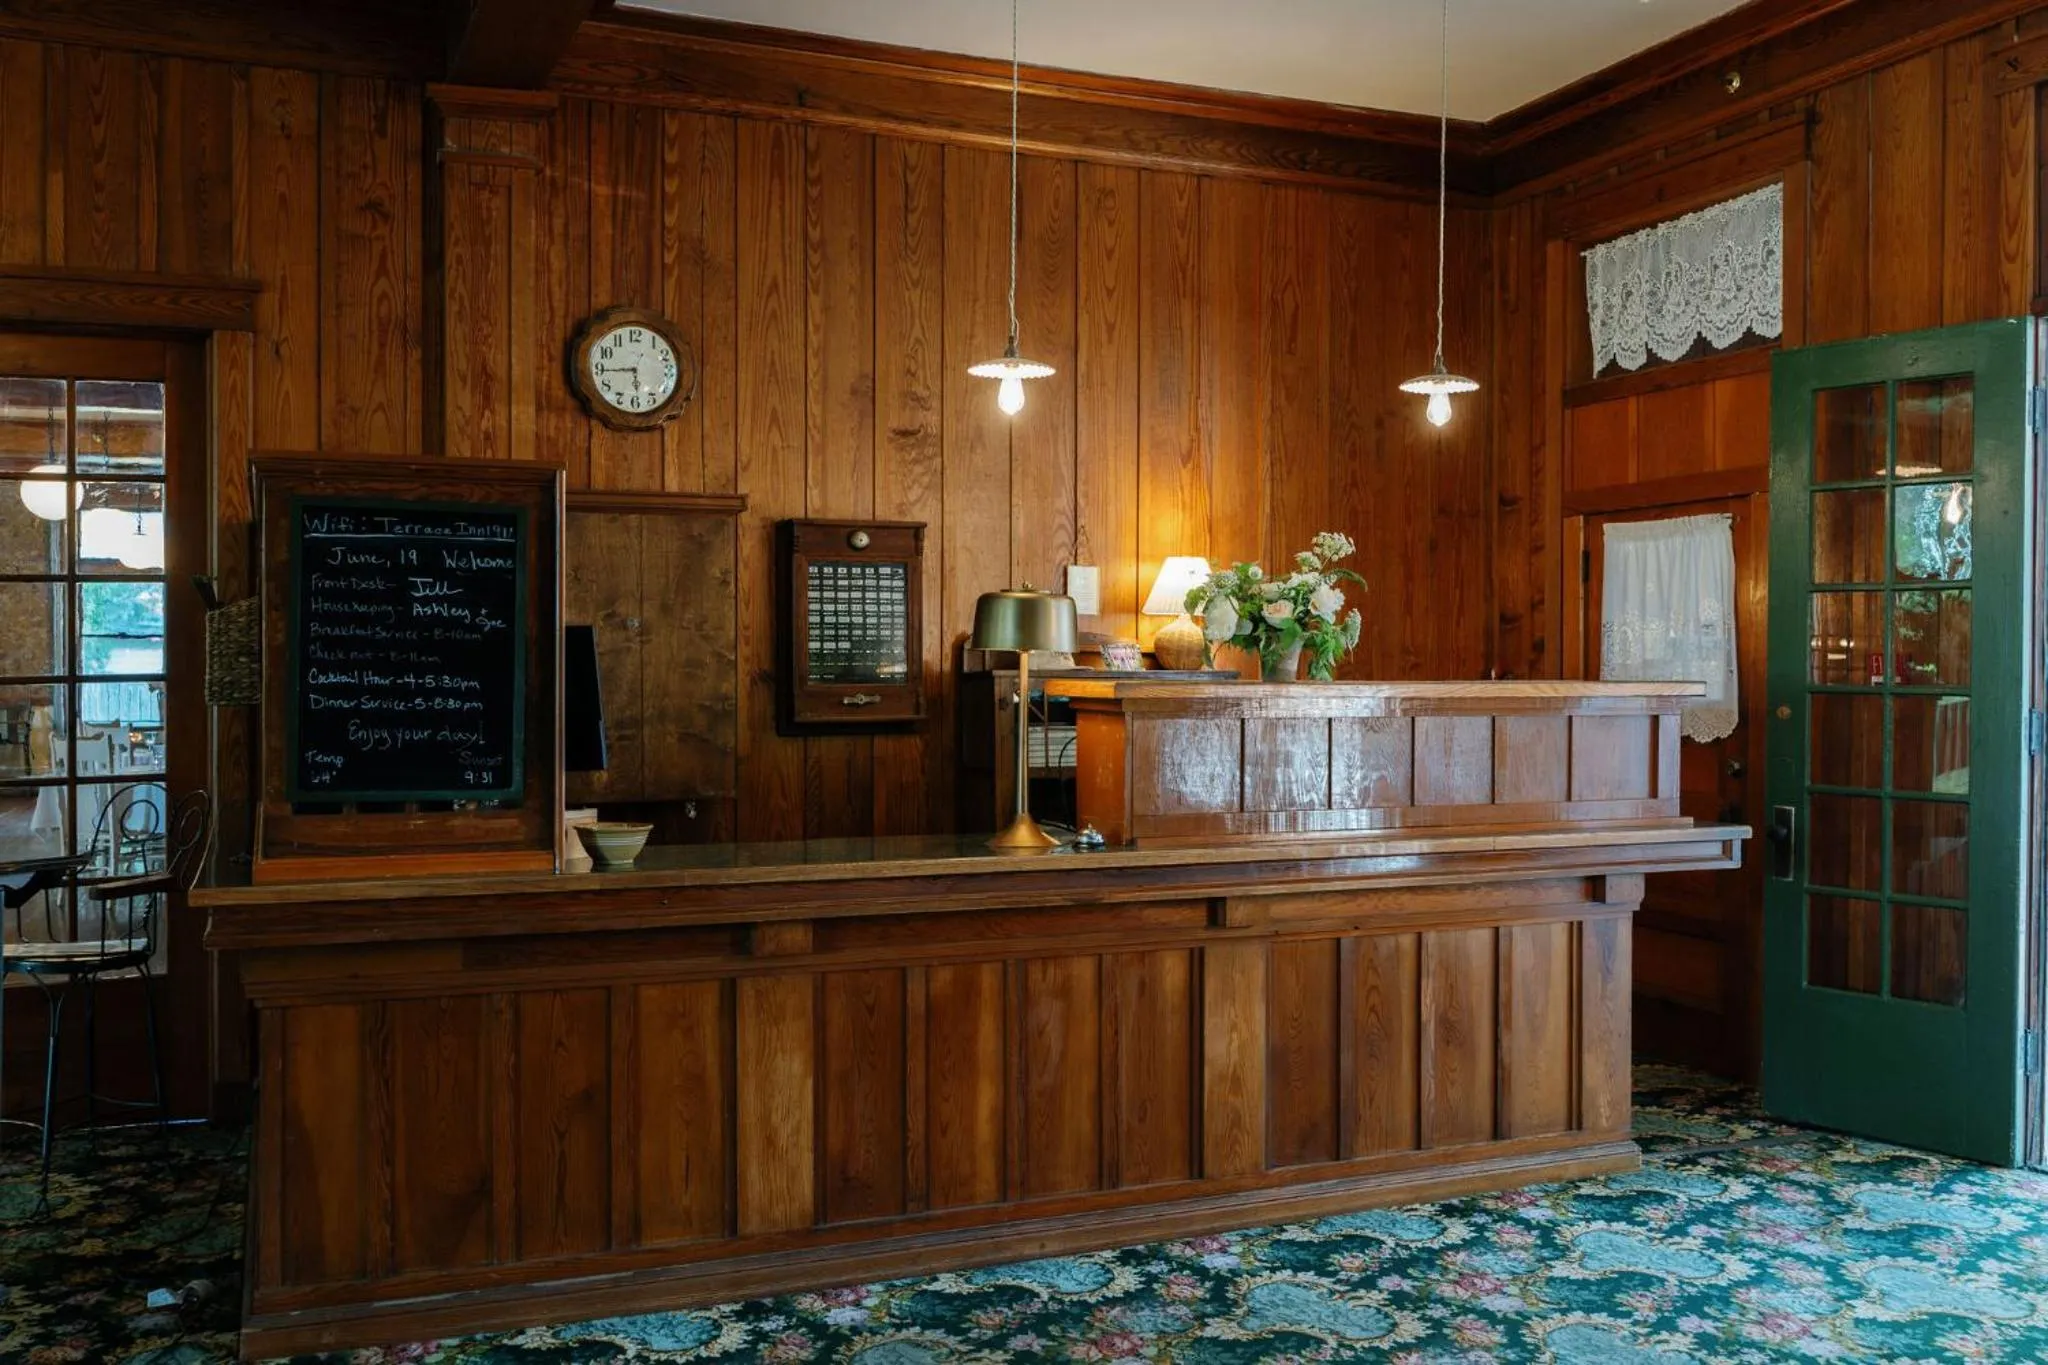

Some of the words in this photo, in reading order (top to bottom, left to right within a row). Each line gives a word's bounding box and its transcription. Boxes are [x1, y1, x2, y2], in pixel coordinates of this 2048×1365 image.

[614, 333, 622, 347] 11
[629, 329, 642, 343] 12
[651, 335, 656, 349] 1
[600, 346, 613, 359] 10
[660, 349, 669, 362] 2
[595, 362, 605, 376] 9
[601, 379, 611, 392] 8
[615, 392, 624, 405] 7
[630, 395, 640, 409] 6
[647, 392, 656, 405] 5
[327, 547, 391, 568] June,
[400, 549, 417, 565] 19
[443, 550, 515, 569] Welcome
[408, 577, 463, 597] Jill
[413, 602, 471, 624] Ashley
[308, 667, 359, 685] Cocktail
[309, 694, 356, 709] Dinner
[348, 719, 392, 751] Enjoy
[395, 728, 432, 748] your
[305, 751, 344, 769] Temp
[464, 770, 493, 784] 9:31
